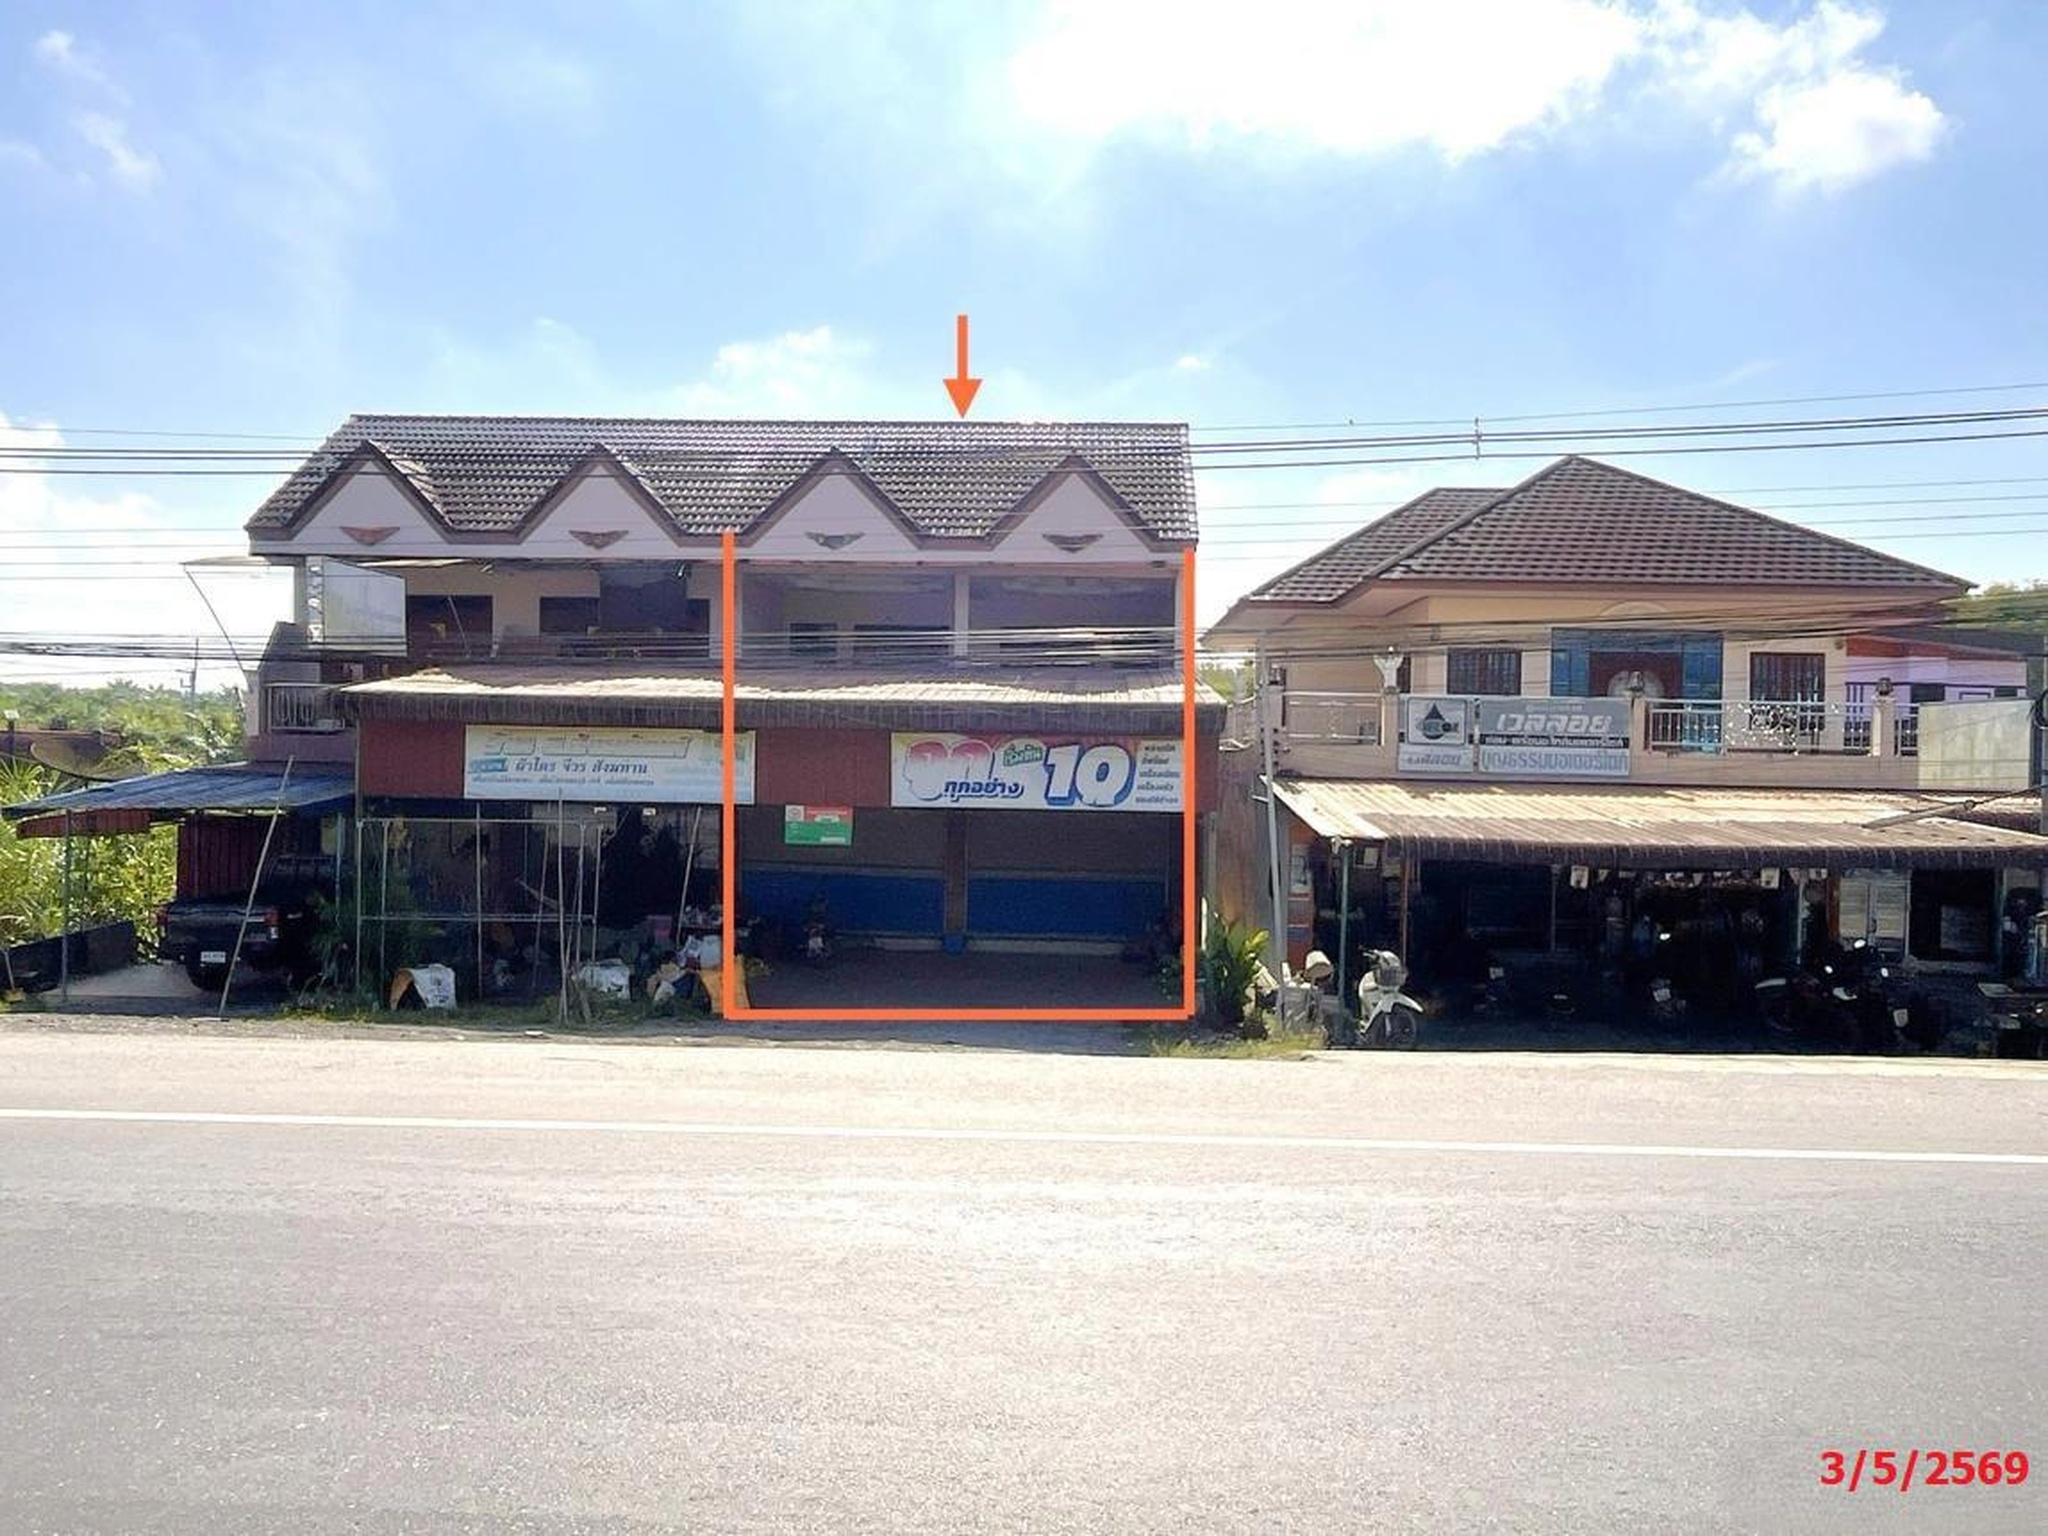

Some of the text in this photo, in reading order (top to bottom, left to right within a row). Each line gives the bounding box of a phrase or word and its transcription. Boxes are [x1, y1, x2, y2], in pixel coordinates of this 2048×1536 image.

[943, 778, 1023, 802] ทุกอย่าง
[1044, 743, 1136, 807] 10
